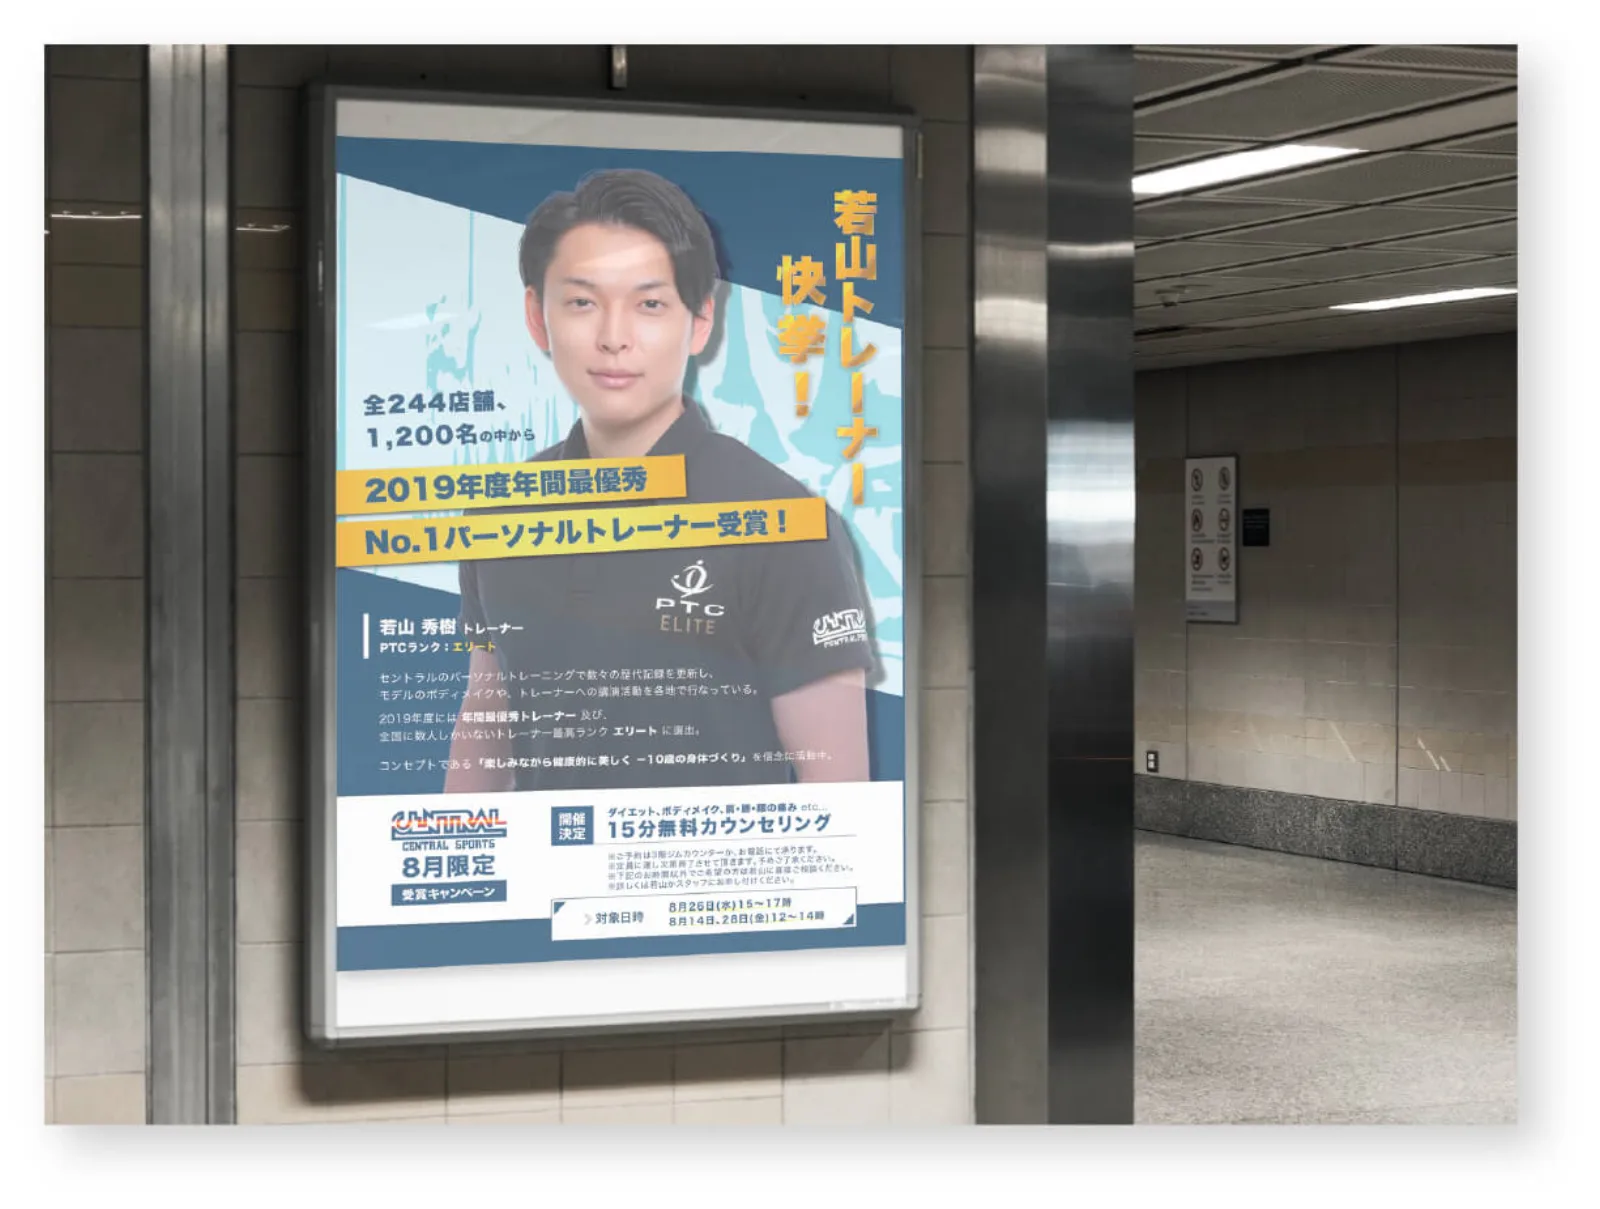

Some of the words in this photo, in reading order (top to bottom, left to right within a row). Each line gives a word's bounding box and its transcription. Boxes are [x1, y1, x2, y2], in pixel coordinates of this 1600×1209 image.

[834, 190, 878, 506] 若山トレーナー
[364, 465, 648, 504] 2019年度年間最優秀
[364, 509, 787, 555] No.1パーソナルトレーナー受賞！
[655, 597, 725, 617] PTC
[379, 618, 415, 636] 若山
[421, 618, 457, 636] 秀樹
[463, 622, 524, 635] トレーナー
[659, 613, 716, 635] ELITE
[379, 712, 456, 725] 2019年度には
[461, 709, 577, 724] 年間最優秀トレーナー
[612, 724, 657, 737] エリート
[558, 812, 586, 827] 開催
[607, 813, 832, 839] 15分無料カウンセリング
[558, 826, 586, 841] 決定
[401, 840, 449, 852] CENTRAL
[455, 838, 496, 850] SPORTS
[401, 853, 496, 879] 8月限定
[401, 886, 496, 902] 受賞キャンペーン
[595, 910, 644, 925] 対象日時
